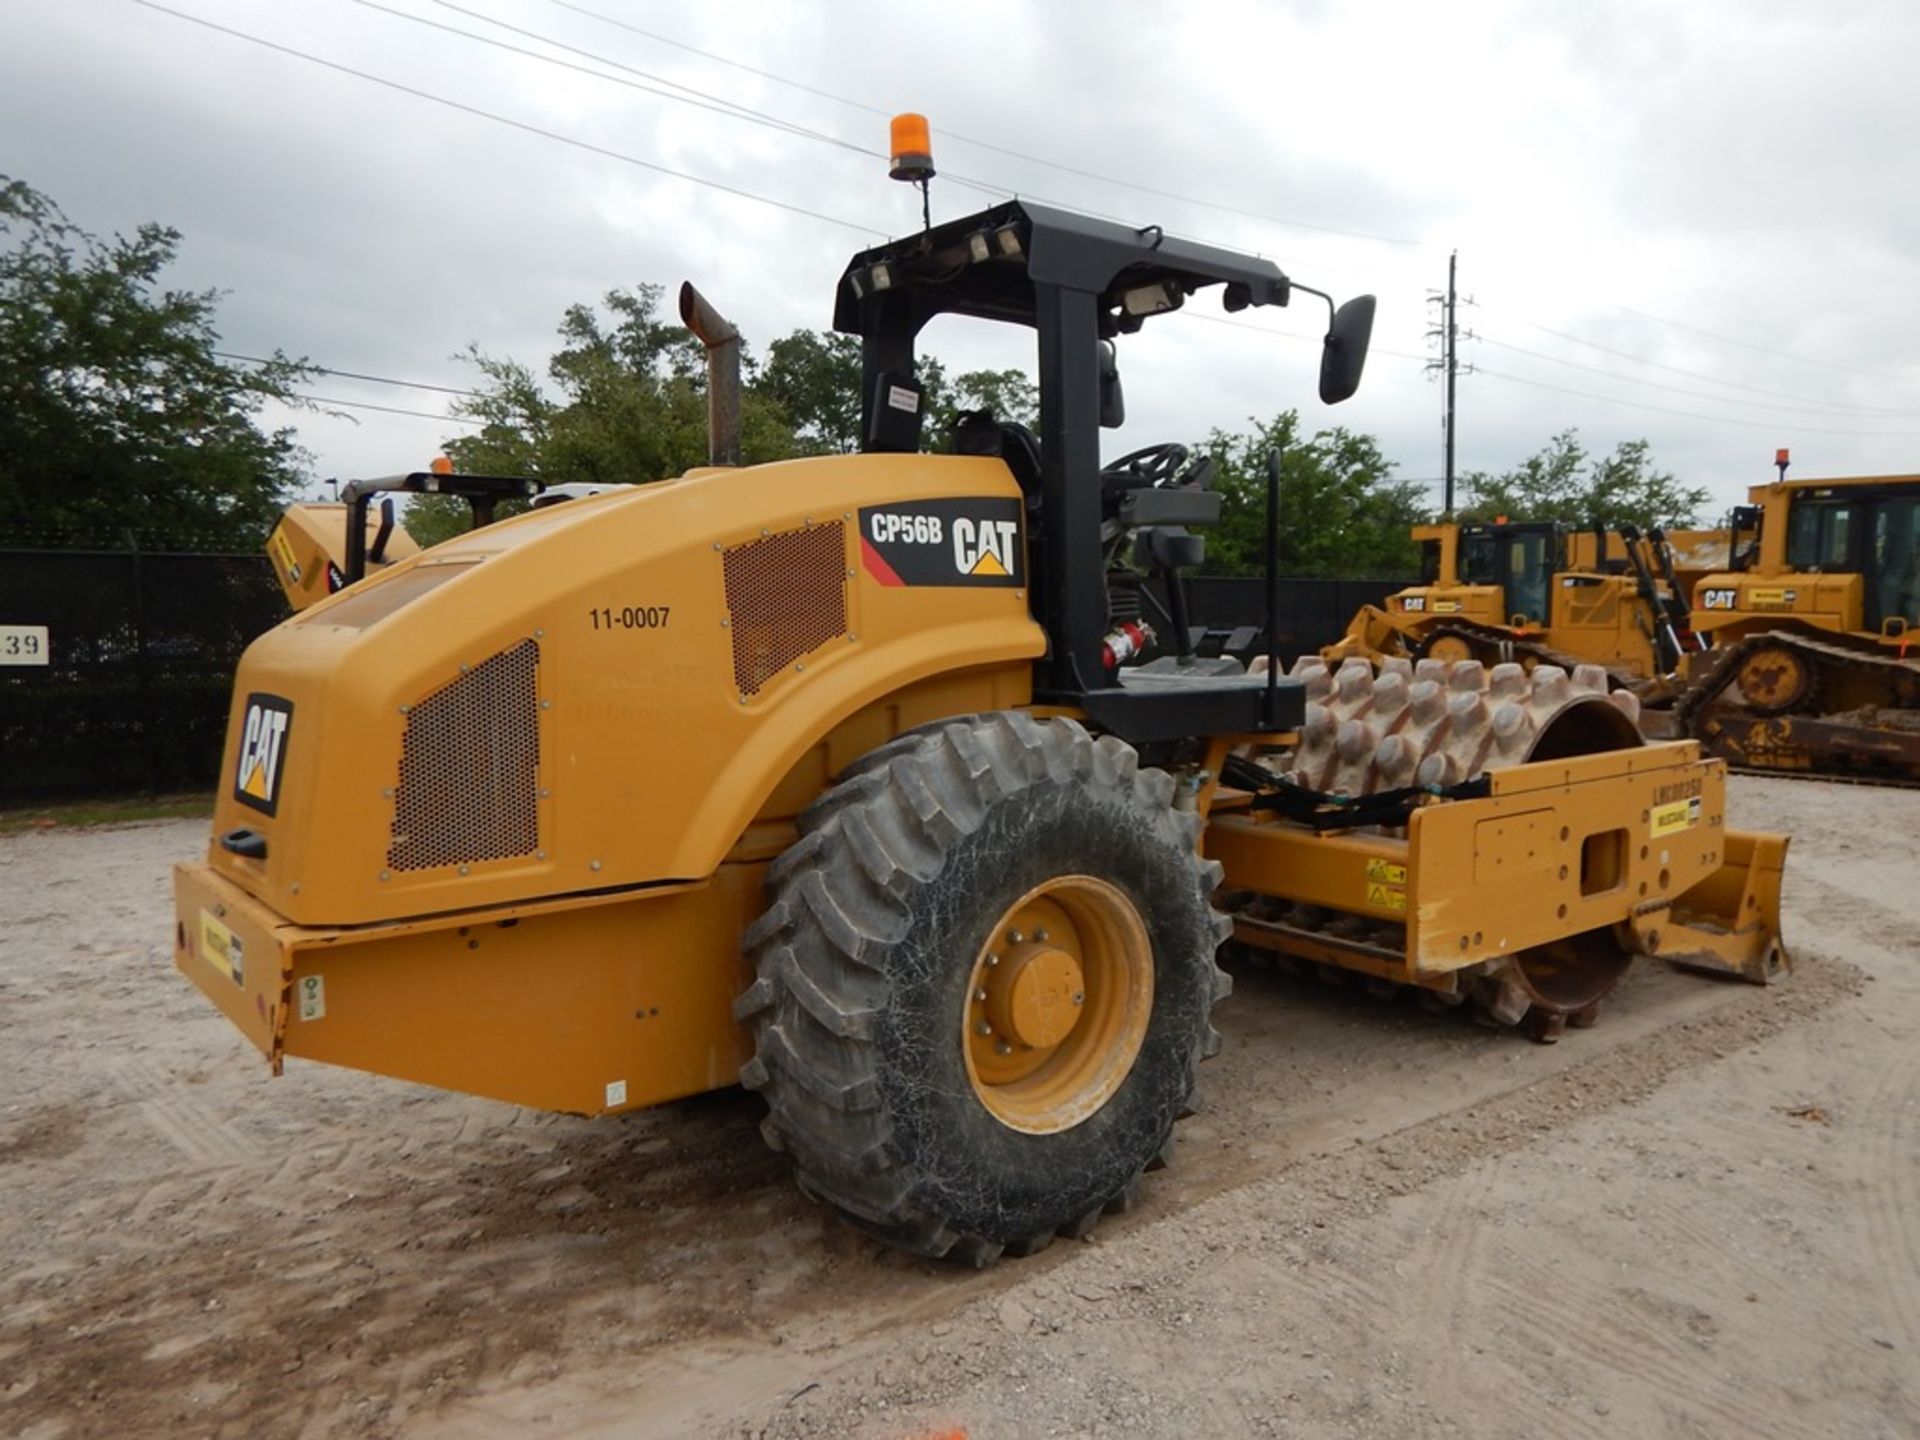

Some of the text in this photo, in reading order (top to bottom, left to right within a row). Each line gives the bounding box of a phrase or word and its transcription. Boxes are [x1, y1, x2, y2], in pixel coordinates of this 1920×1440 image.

[871, 513, 1017, 576] CP56B CAT
[1405, 597, 1425, 611] CAT
[1705, 590, 1736, 609] CAT
[590, 607, 670, 630] 11-0007
[0, 635, 38, 655] 39
[239, 704, 288, 803] CAT
